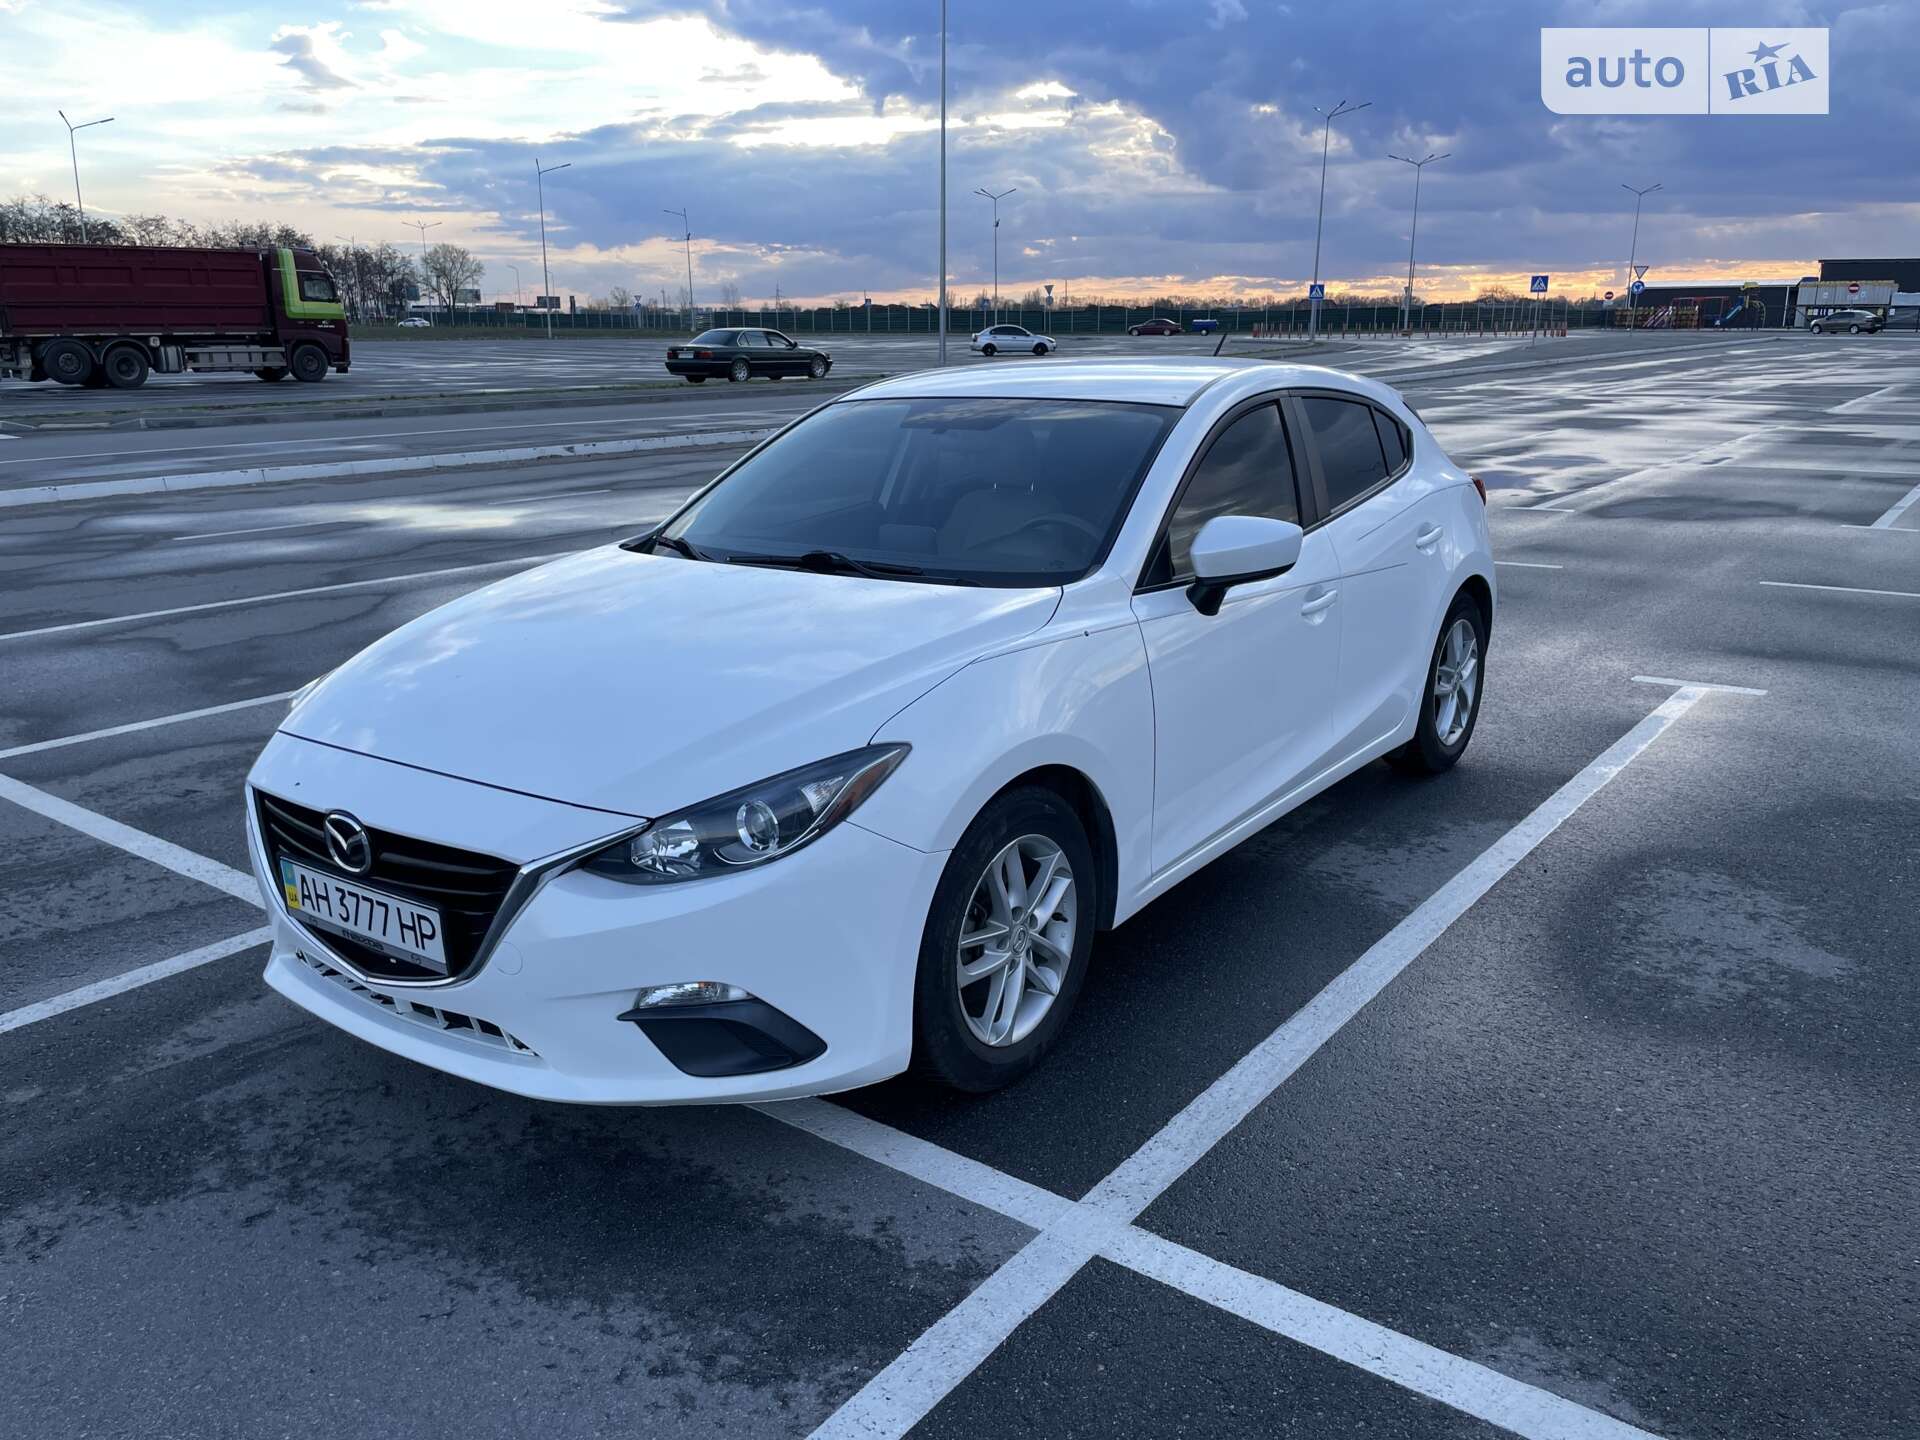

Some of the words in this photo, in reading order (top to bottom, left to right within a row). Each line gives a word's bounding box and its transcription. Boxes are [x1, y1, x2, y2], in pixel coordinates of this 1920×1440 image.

[301, 874, 333, 917] AH
[335, 886, 389, 937] 3777
[396, 907, 436, 950] HP
